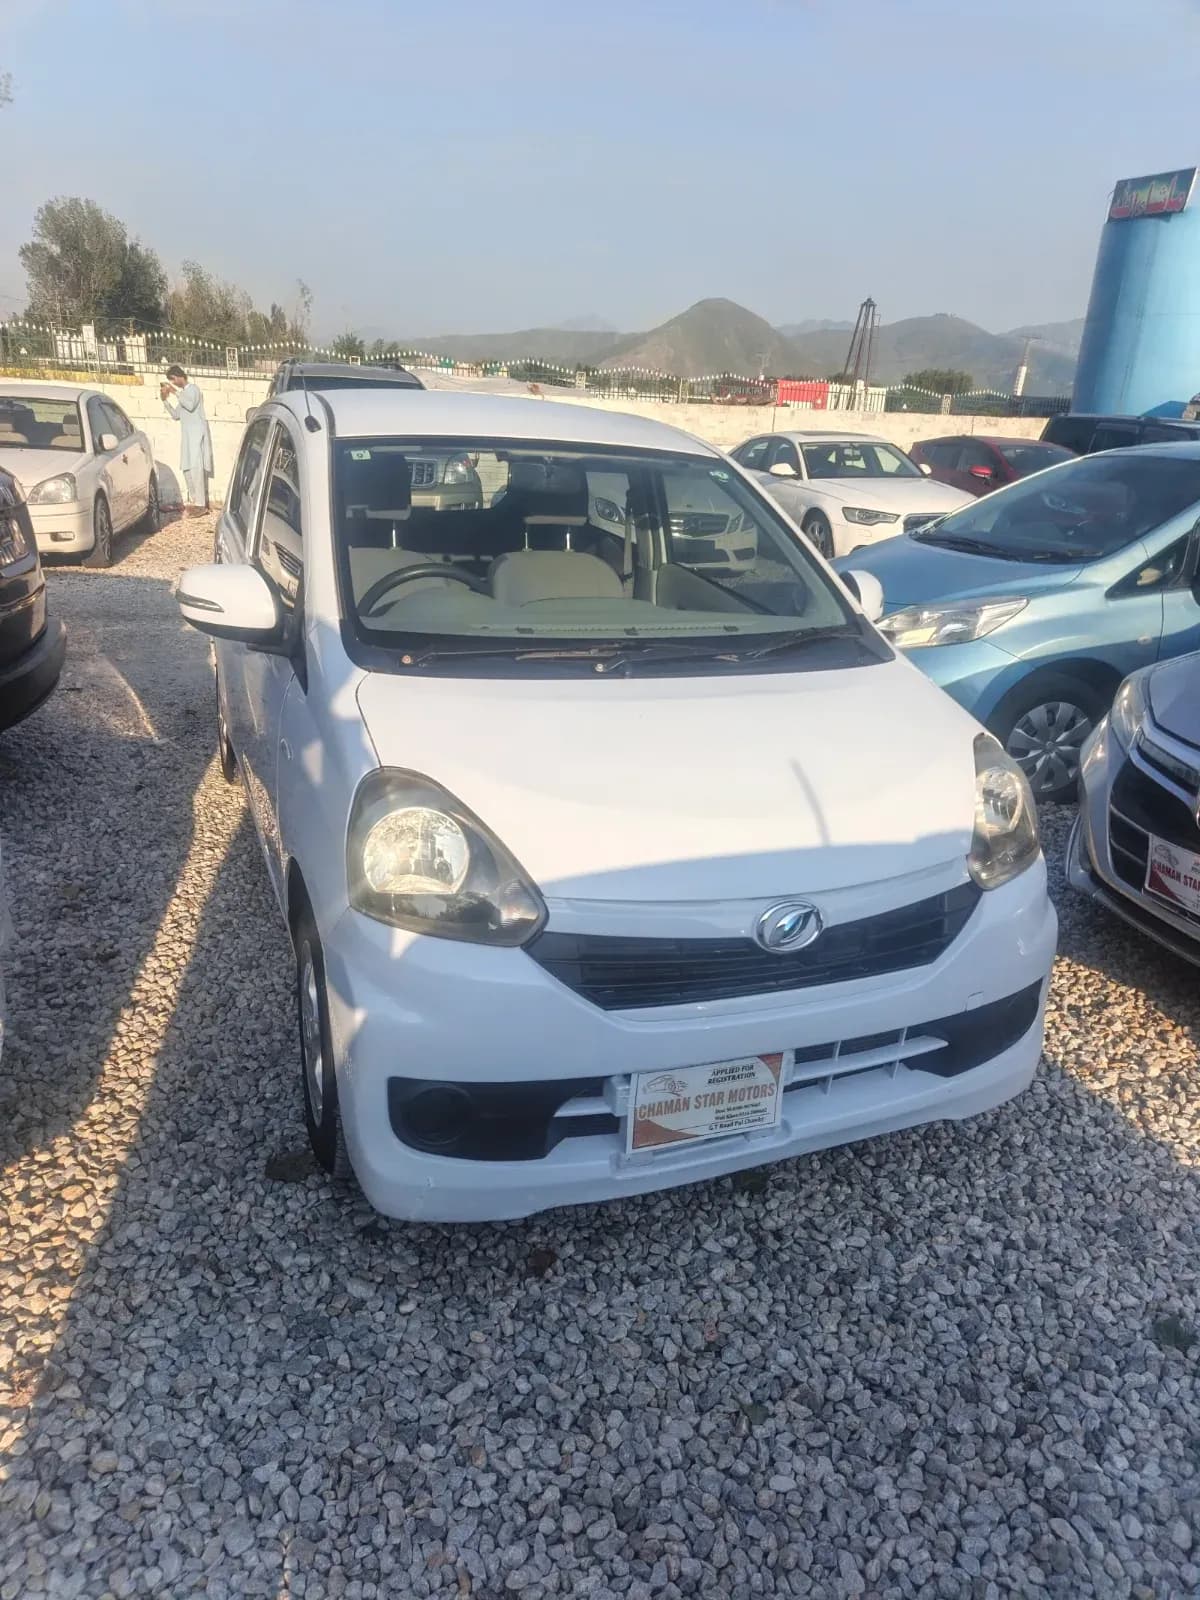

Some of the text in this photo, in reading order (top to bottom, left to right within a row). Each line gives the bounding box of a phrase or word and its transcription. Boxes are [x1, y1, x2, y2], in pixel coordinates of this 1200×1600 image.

[711, 1064, 754, 1077] APPLIED FOR
[708, 1072, 756, 1084] REGISTRATION
[638, 1096, 691, 1119] CHAMAN
[694, 1091, 725, 1110] STAR
[728, 1082, 776, 1103] MOTORS
